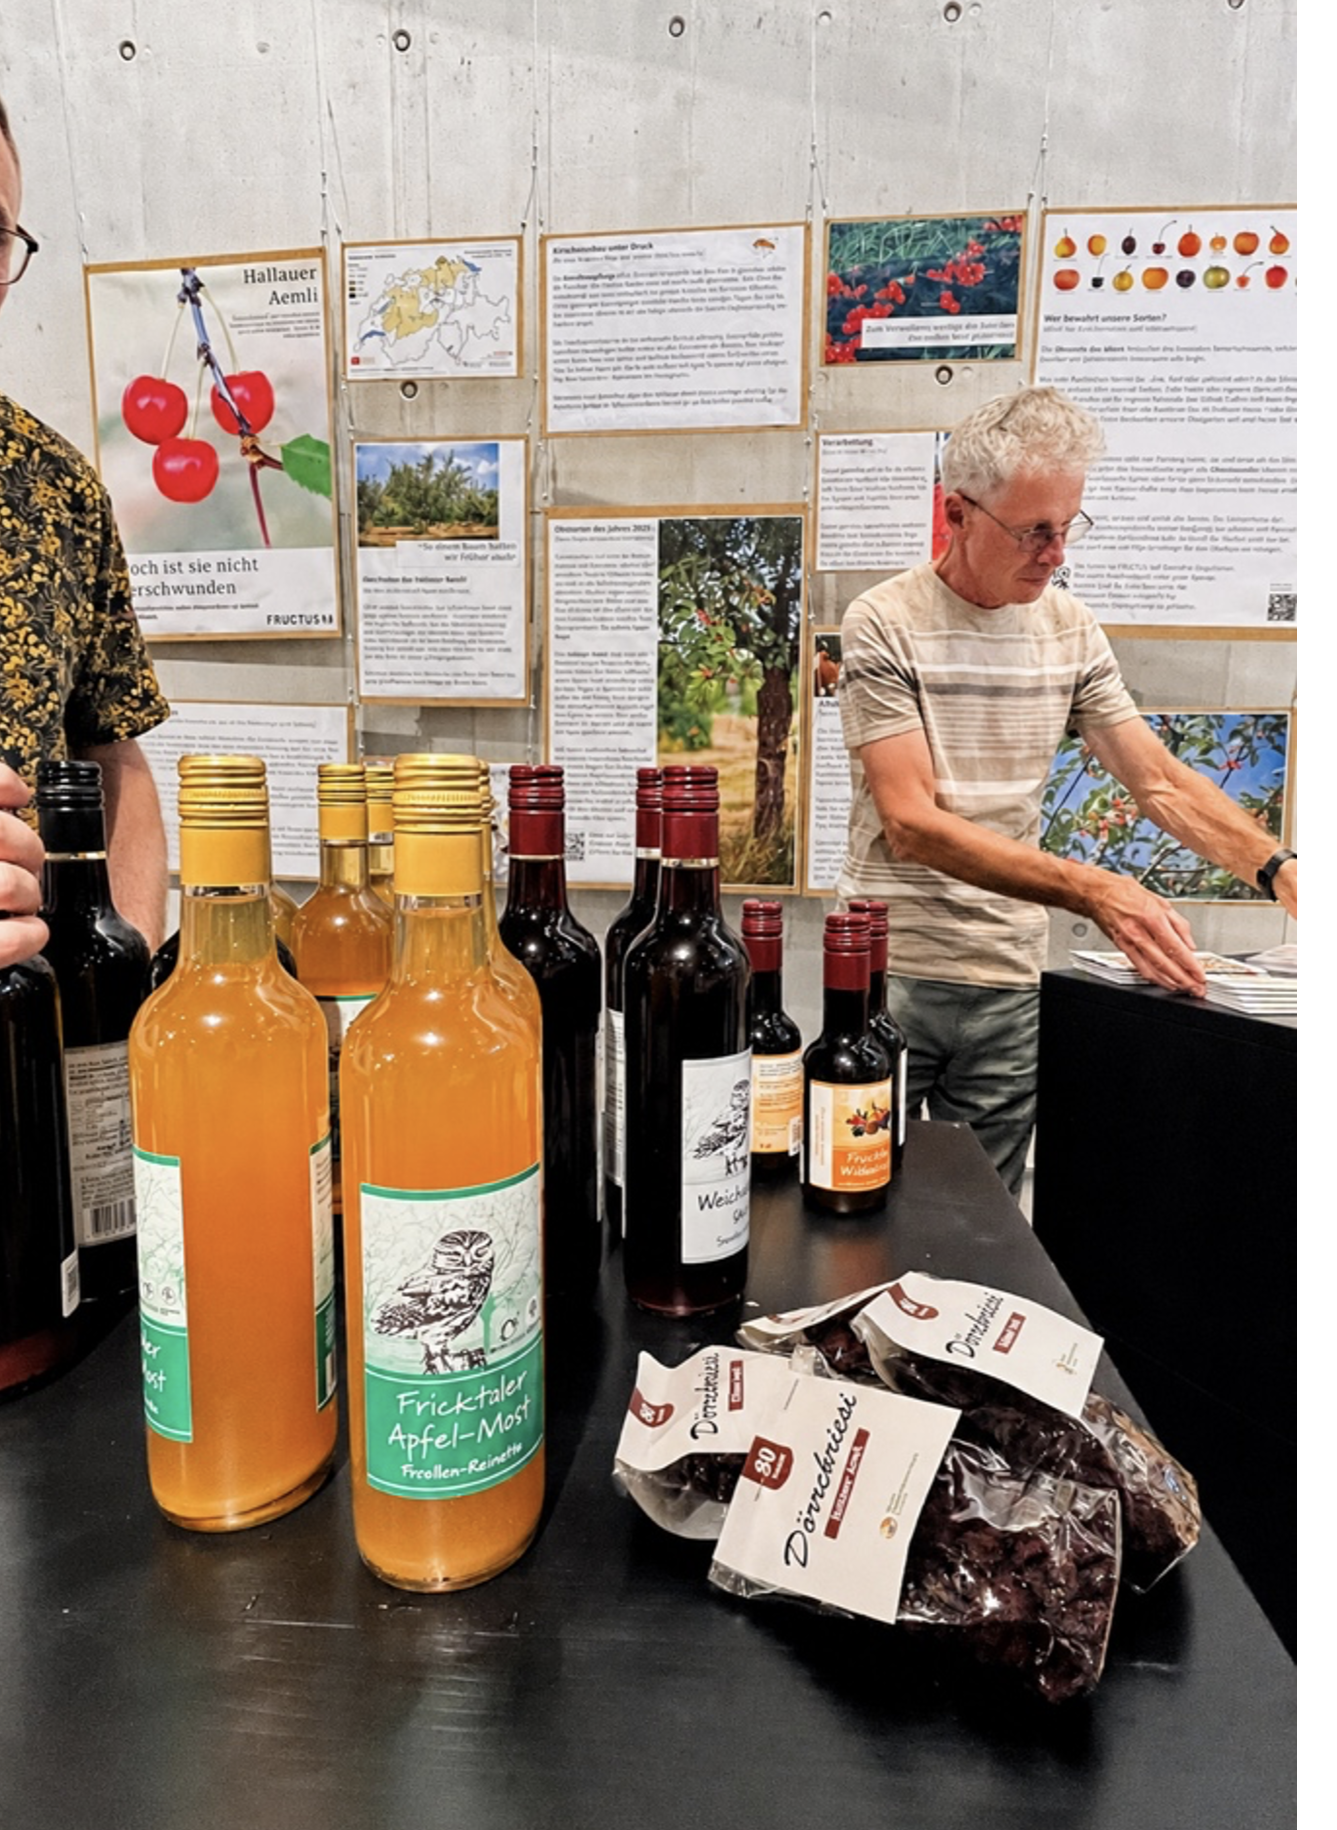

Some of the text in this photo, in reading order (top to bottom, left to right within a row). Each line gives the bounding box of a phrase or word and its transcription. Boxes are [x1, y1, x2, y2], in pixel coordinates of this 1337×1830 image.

[243, 266, 317, 284] Hallauer
[268, 286, 319, 305] Aemli
[130, 557, 259, 575] och ist sie nicht
[130, 580, 237, 597] erschwunden
[266, 614, 320, 626] FRUCTUS
[396, 1370, 528, 1417] Fricktaler
[388, 1393, 532, 1463] Apfel-Most
[753, 1446, 777, 1478] 80
